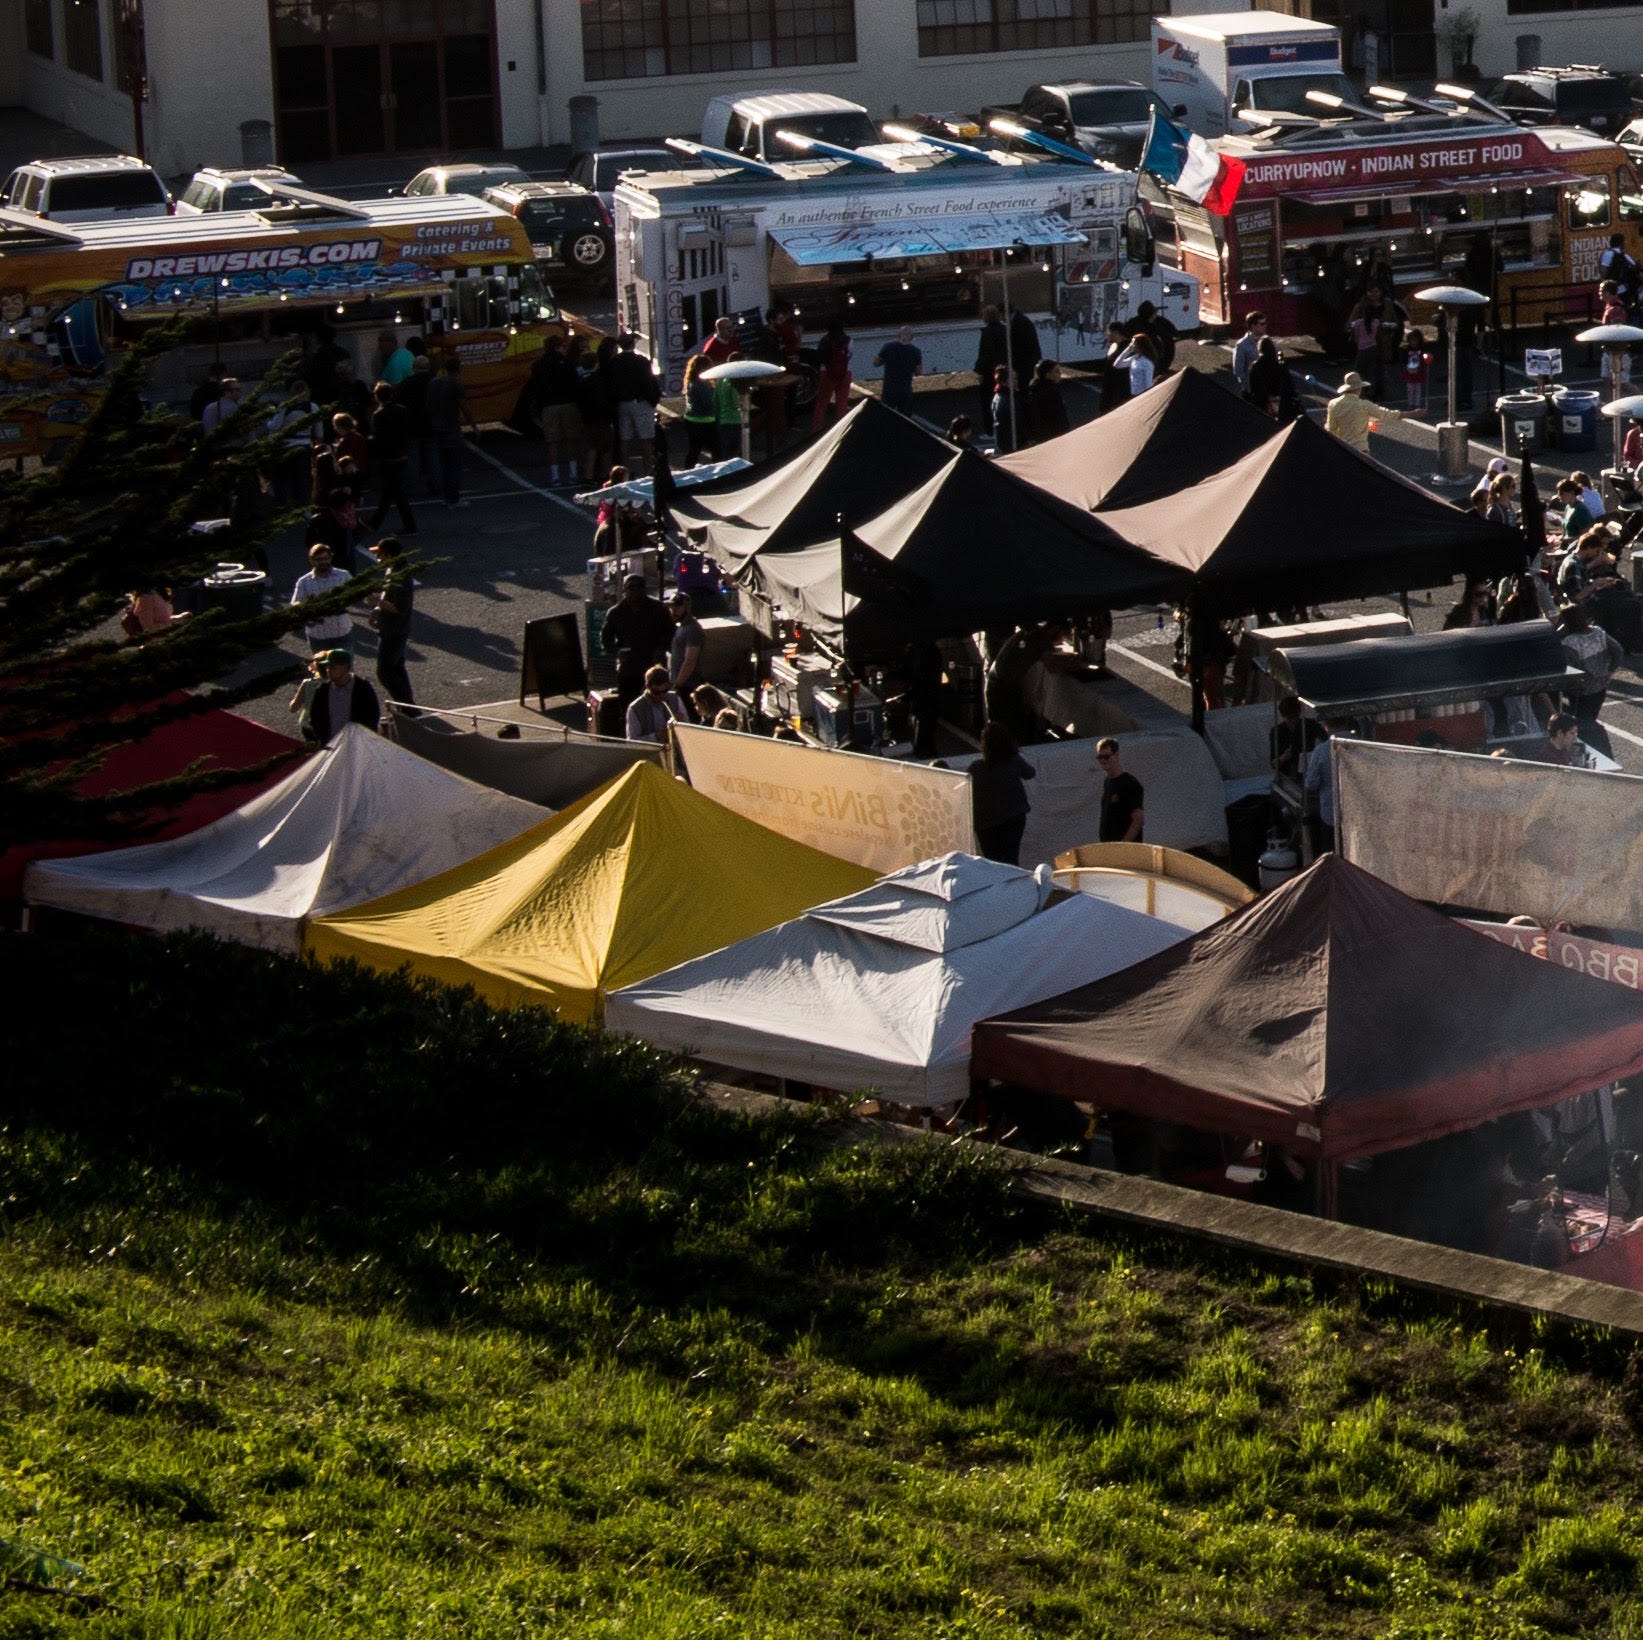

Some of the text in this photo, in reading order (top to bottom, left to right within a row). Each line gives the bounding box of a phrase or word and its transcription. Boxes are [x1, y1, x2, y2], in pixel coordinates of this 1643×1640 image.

[1244, 144, 1523, 184] CURRYUPNOW INDIAN STREET FOOD
[776, 198, 1038, 225] An authentic French Street Food experience
[417, 222, 480, 240] Catering
[402, 238, 511, 258] Private Events
[1570, 236, 1611, 252] INDIAN
[128, 241, 381, 280] DREWSKIS.COM
[1572, 265, 1600, 283] FOO
